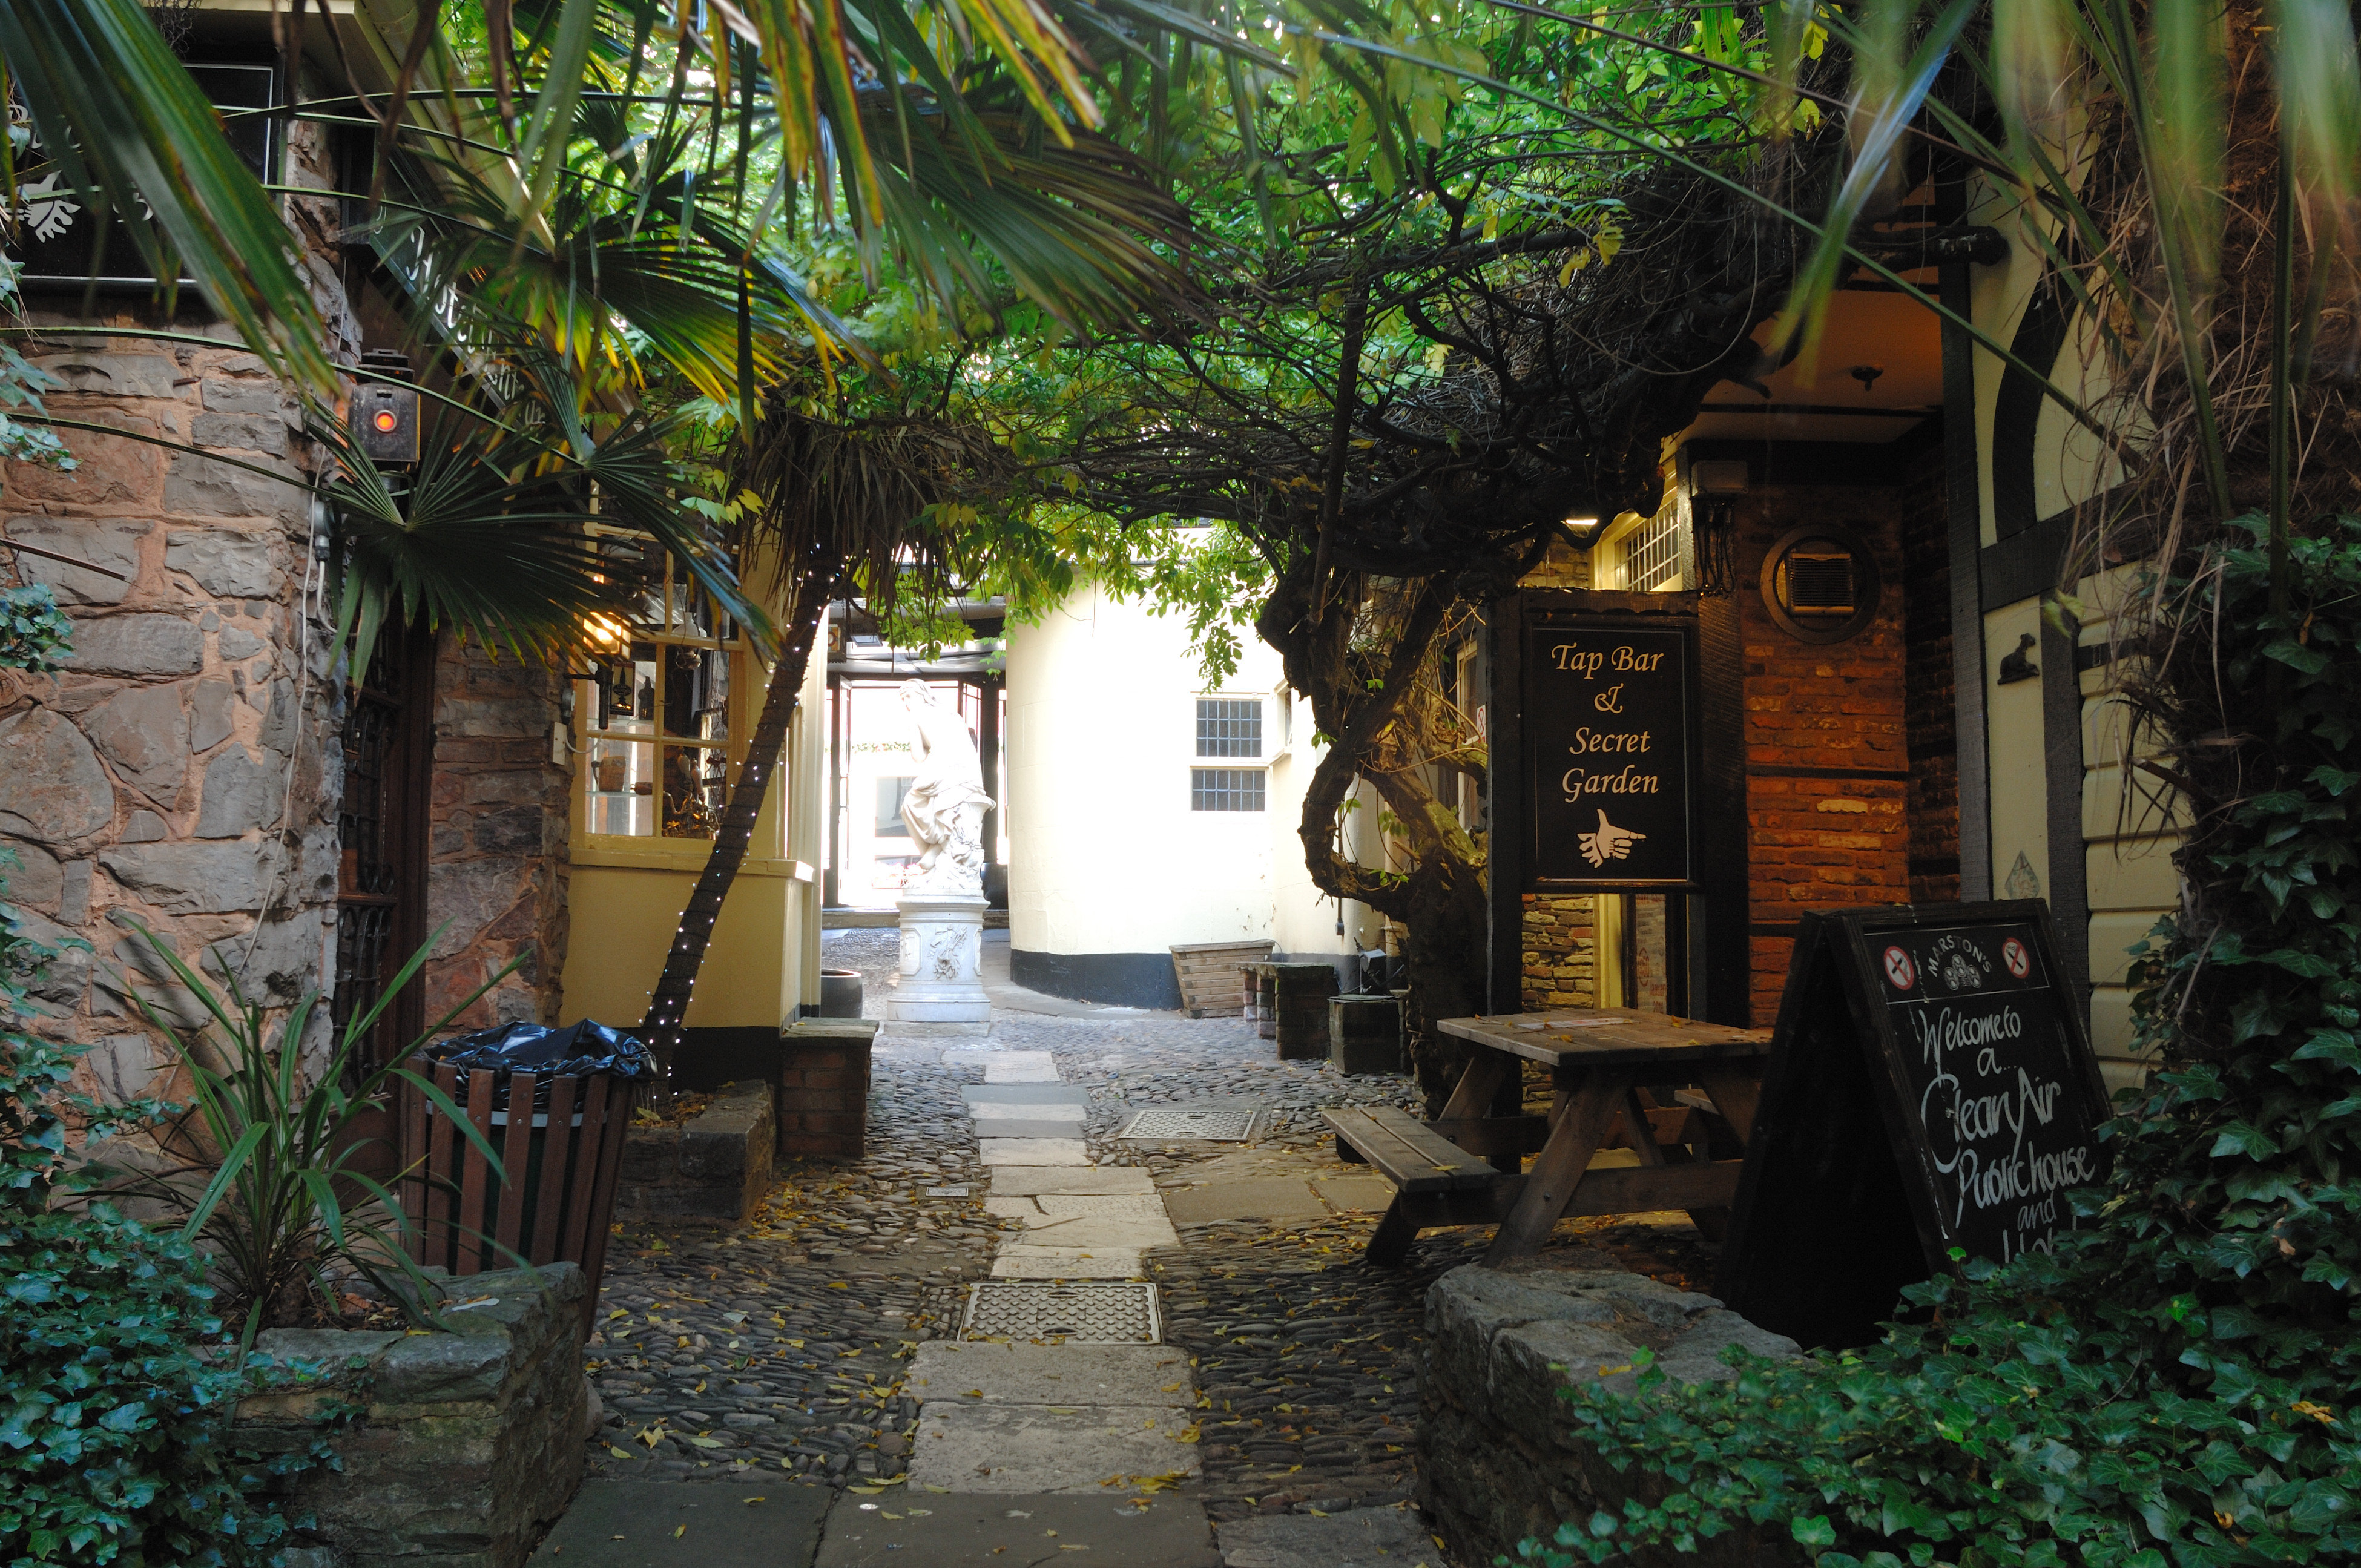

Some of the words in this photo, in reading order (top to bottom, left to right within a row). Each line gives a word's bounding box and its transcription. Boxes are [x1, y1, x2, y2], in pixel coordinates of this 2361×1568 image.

[1551, 642, 1603, 679] Tap
[1611, 645, 1664, 672] Bar
[1594, 683, 1624, 713] &
[1569, 727, 1650, 754] Secret
[1562, 765, 1659, 803] Garden
[1928, 935, 1992, 977] MARSTON'S
[1921, 1073, 2018, 1174] Clean
[1955, 1149, 2030, 1228] Public
[2028, 1141, 2095, 1195] house
[2017, 1191, 2056, 1231] and
